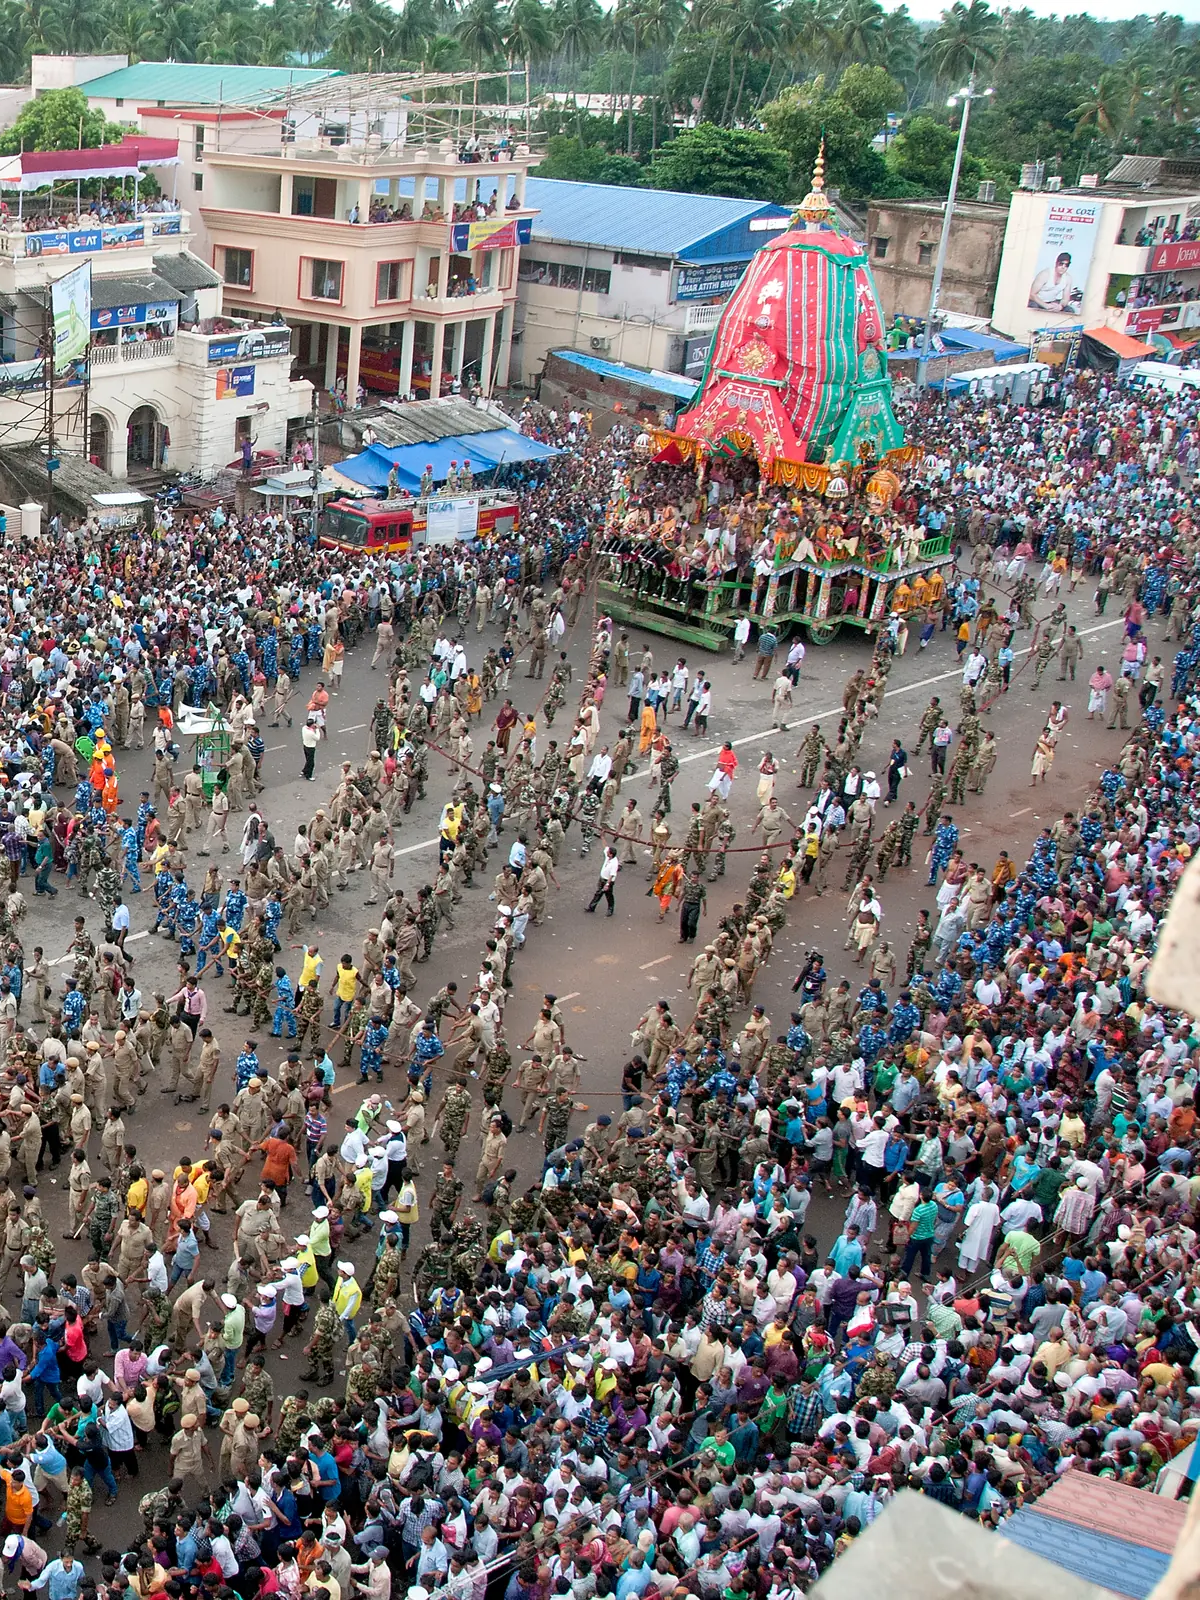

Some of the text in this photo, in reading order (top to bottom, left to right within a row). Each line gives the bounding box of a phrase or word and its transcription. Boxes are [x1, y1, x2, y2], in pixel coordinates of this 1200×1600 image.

[1076, 207, 1096, 216] cozi
[73, 236, 97, 247] CEAT
[1176, 247, 1200, 265] JOHN
[678, 284, 698, 293] BIHAR
[699, 281, 719, 291] ATITHI
[117, 306, 137, 317] CEAT
